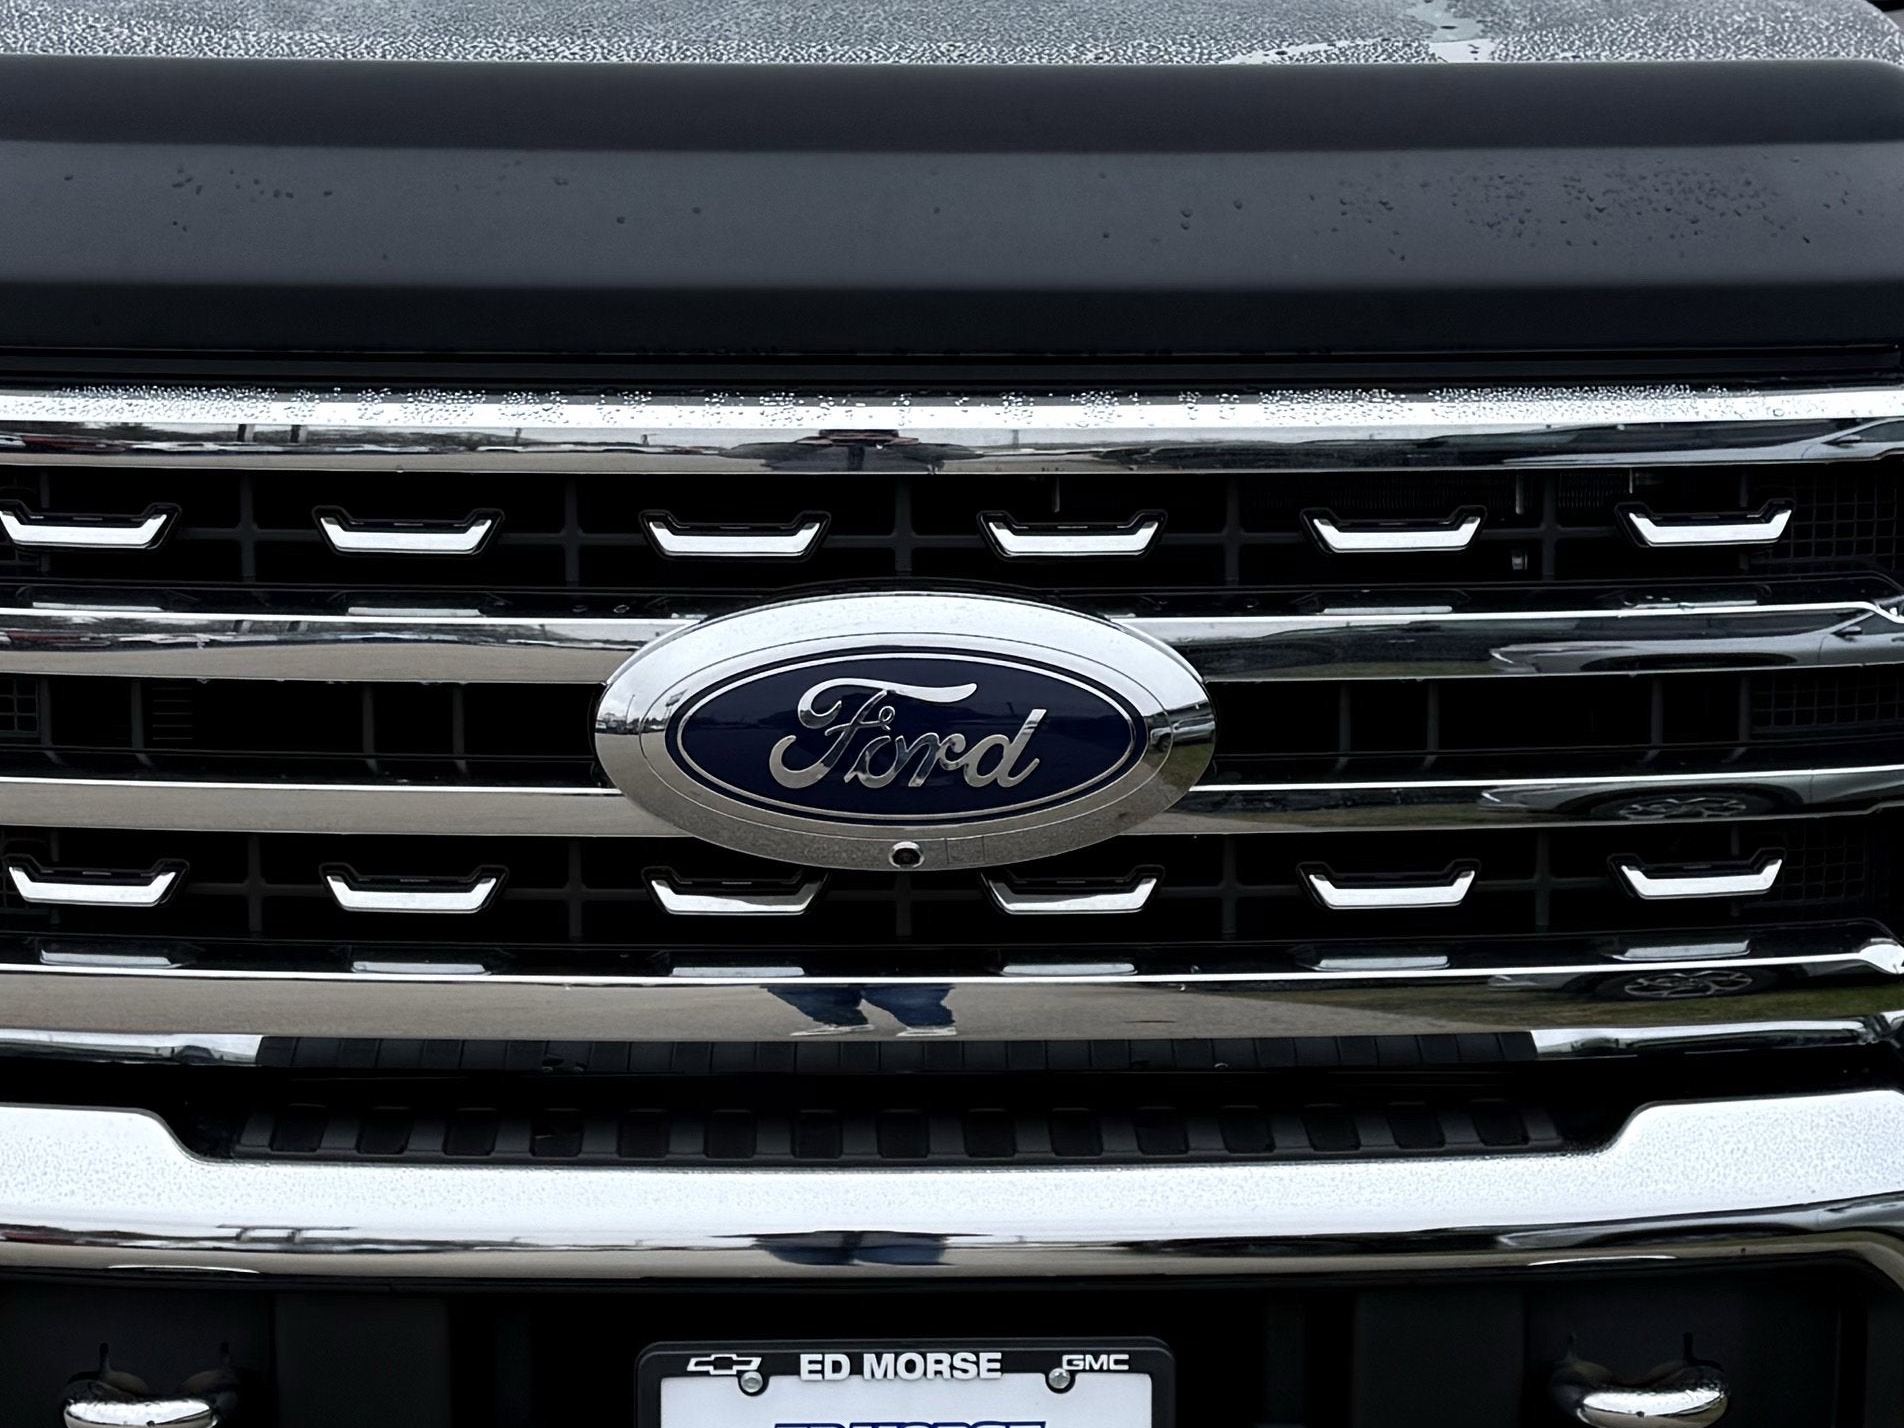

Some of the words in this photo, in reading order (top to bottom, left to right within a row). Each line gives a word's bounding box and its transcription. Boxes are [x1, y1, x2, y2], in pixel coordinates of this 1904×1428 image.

[769, 678, 1048, 788] Ford
[799, 1353, 851, 1381] ED
[863, 1351, 1002, 1381] MORSE
[1062, 1354, 1130, 1371] GMC
